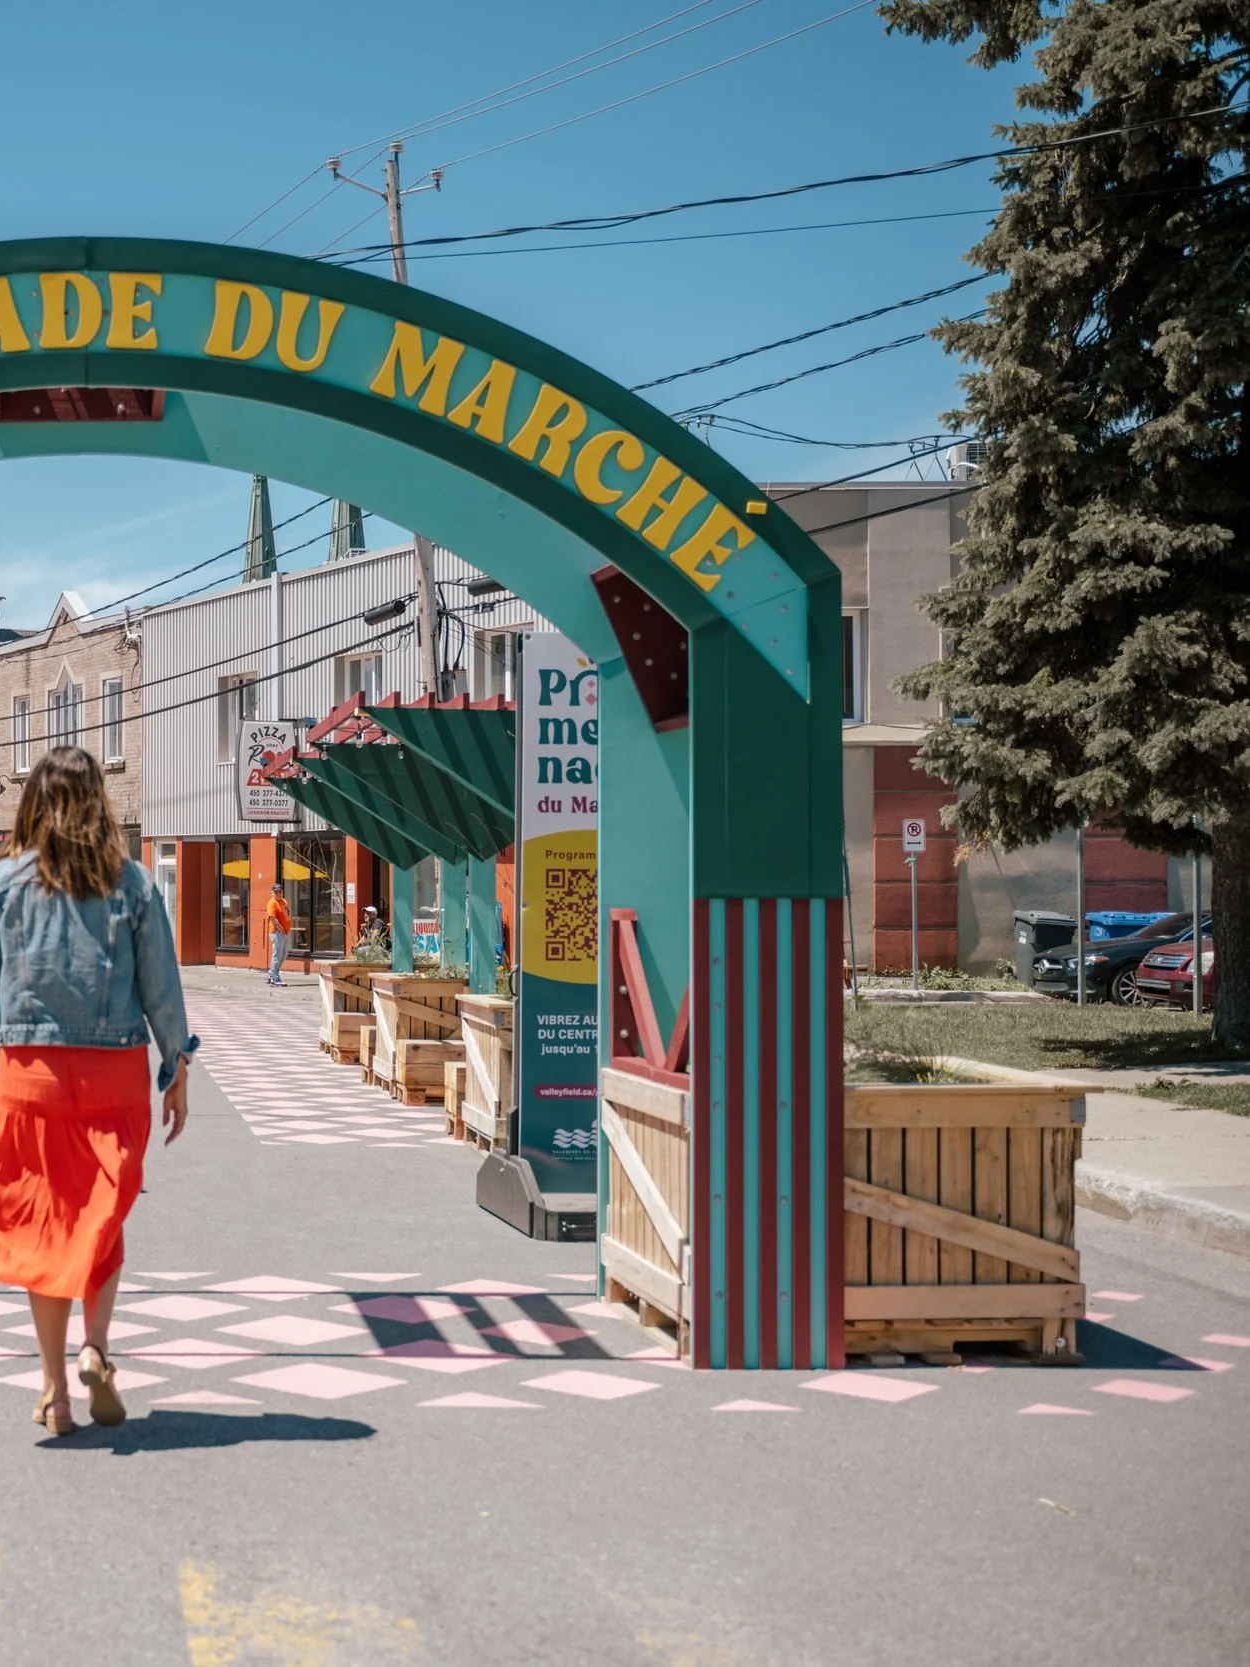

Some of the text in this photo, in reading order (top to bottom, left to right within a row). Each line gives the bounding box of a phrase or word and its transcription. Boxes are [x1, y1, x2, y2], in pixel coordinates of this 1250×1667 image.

[204, 278, 346, 372] DU
[370, 320, 768, 592] MARCHÉ
[251, 726, 286, 744] PIZZA
[538, 717, 598, 745] me
[538, 756, 598, 785] na
[249, 789, 261, 797] 450
[262, 799, 289, 807] 377-0377
[537, 796, 598, 814] du Ma
[537, 1014, 580, 1025] VIBREZ
[538, 1029, 555, 1039] DU
[541, 1043, 590, 1056] jusqu'au
